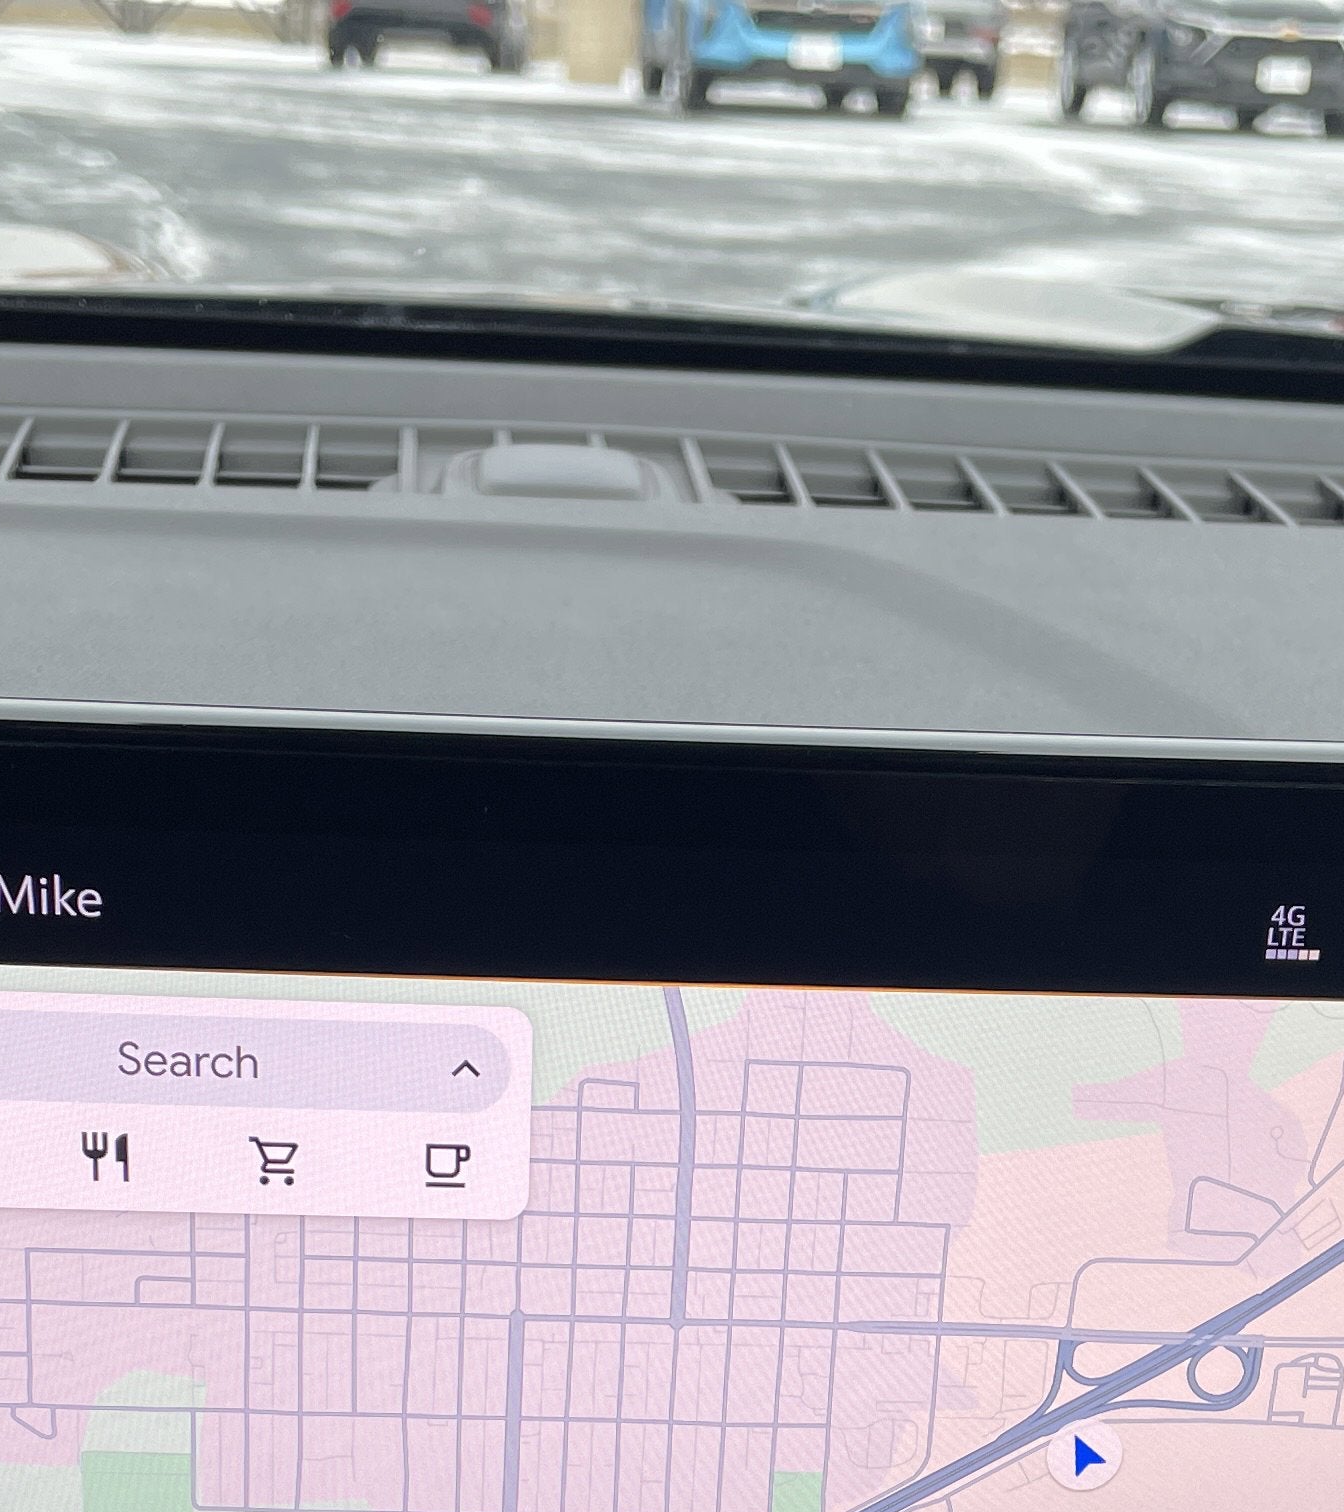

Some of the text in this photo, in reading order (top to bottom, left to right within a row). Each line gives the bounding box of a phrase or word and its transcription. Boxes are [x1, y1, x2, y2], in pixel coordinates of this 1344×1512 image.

[1270, 905, 1306, 926] 4G
[1267, 928, 1306, 947] LTE
[117, 1041, 260, 1081] Search
